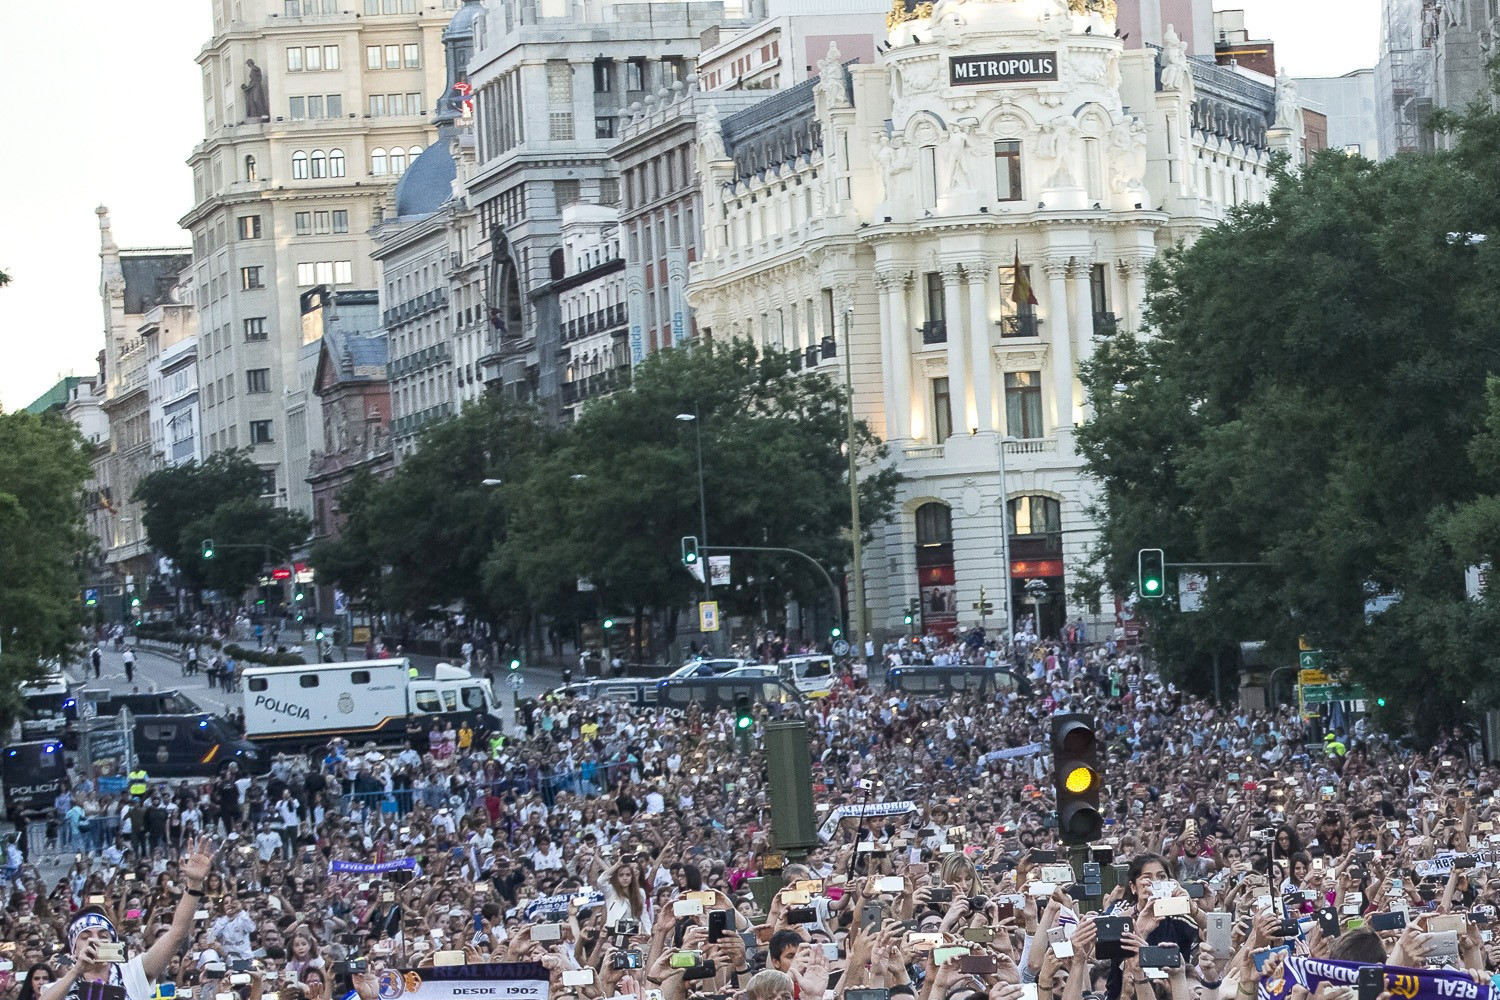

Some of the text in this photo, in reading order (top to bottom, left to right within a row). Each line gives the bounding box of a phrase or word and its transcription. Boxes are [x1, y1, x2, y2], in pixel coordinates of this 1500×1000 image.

[954, 58, 1053, 79] METROPOLIS
[254, 694, 311, 721] POLICIA
[866, 801, 910, 812] MADRID
[1306, 958, 1360, 984] ADRID
[452, 987, 539, 995] DESDE 1902
[1435, 977, 1478, 999] REAL
